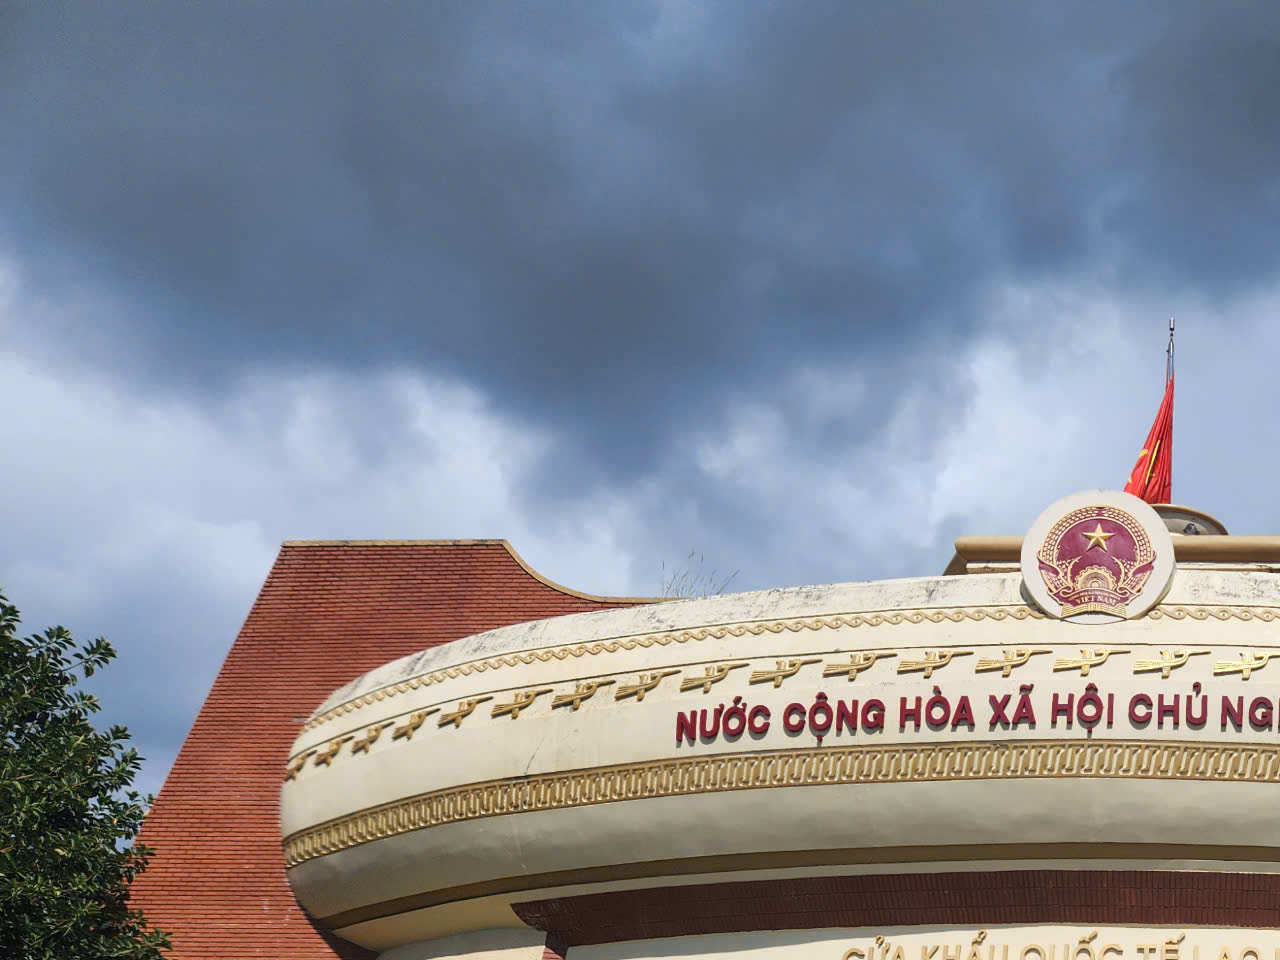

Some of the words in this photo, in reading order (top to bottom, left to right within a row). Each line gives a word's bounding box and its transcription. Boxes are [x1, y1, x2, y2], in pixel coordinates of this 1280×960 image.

[676, 696, 771, 741] NƯỚC
[783, 692, 885, 742] CỘNG
[900, 685, 974, 728] HÒA
[989, 684, 1036, 726] XÃ
[1052, 682, 1114, 733] HỘI
[1129, 682, 1207, 725] CHỦ
